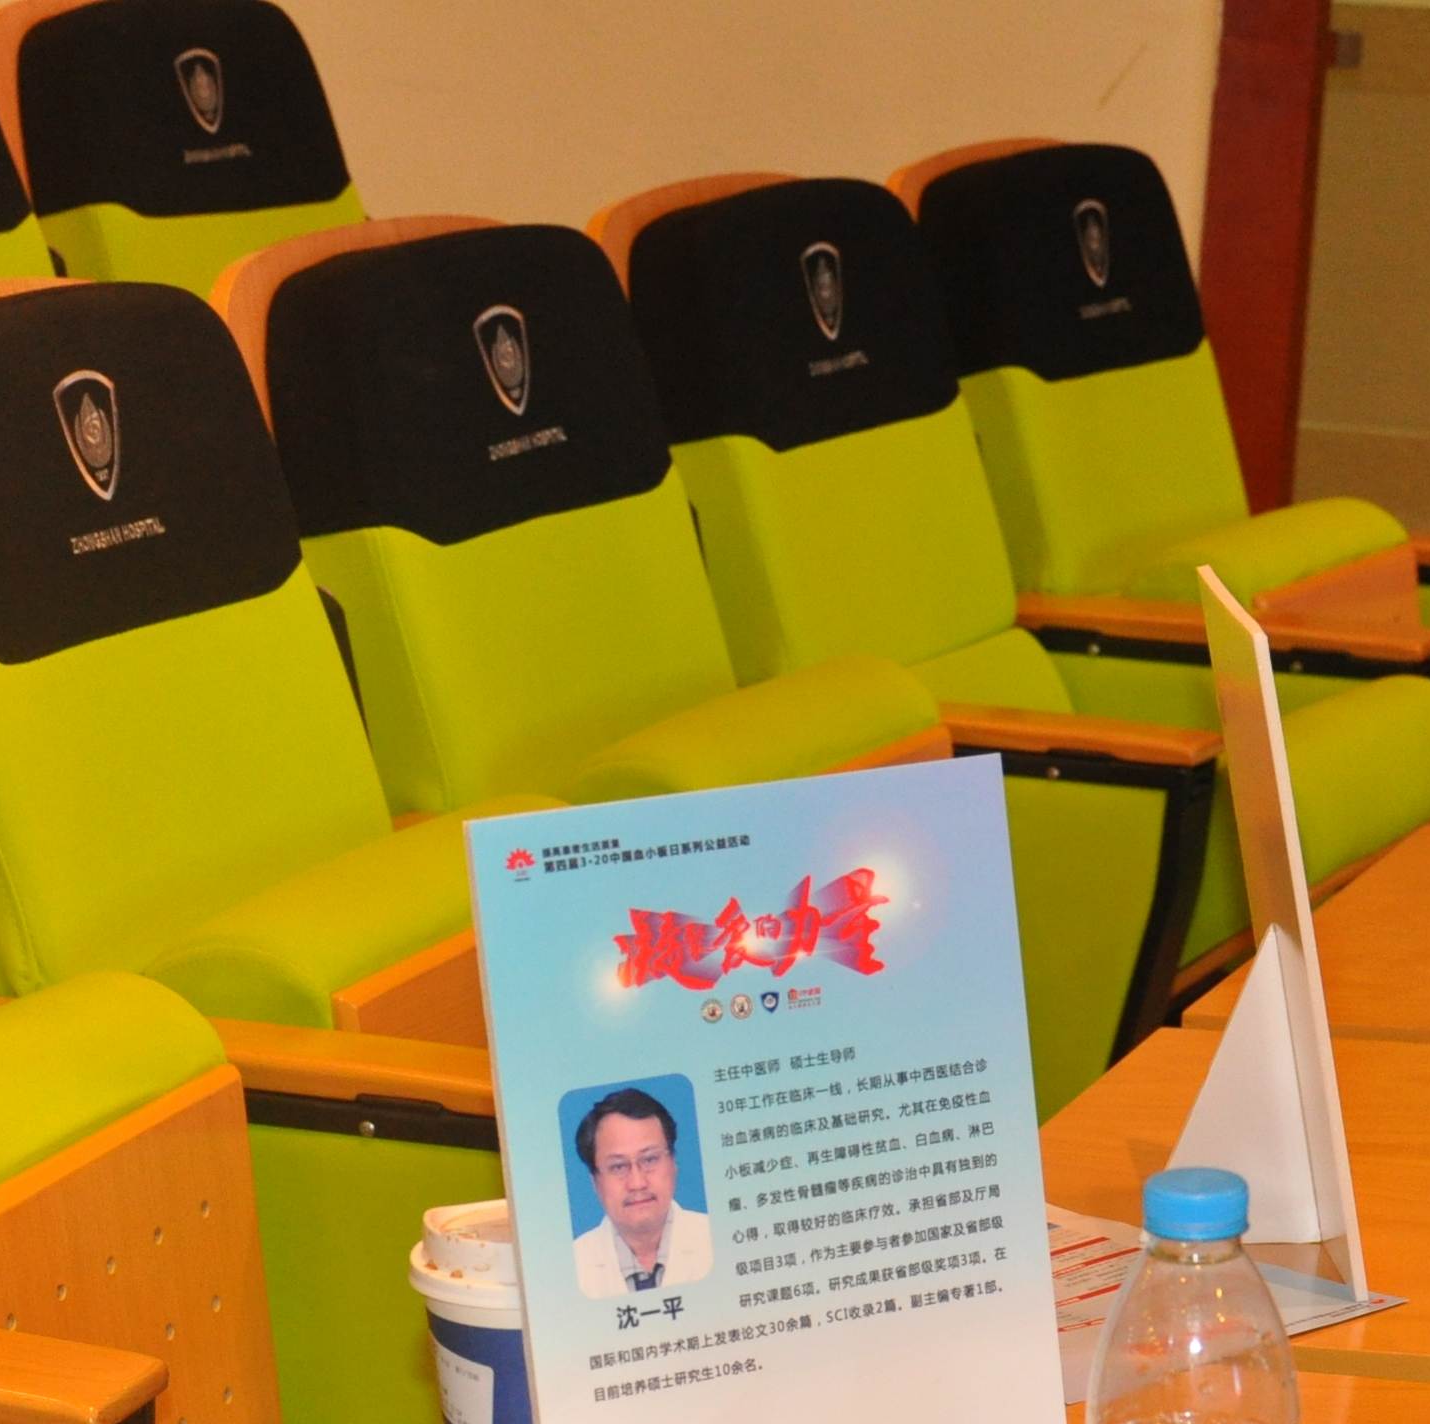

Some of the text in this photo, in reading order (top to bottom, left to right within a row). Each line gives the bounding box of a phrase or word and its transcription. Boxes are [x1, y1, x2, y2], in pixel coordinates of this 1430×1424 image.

[714, 1046, 856, 1083] 主任中医师 硕士生导师
[616, 1295, 685, 1331] 沈一平
